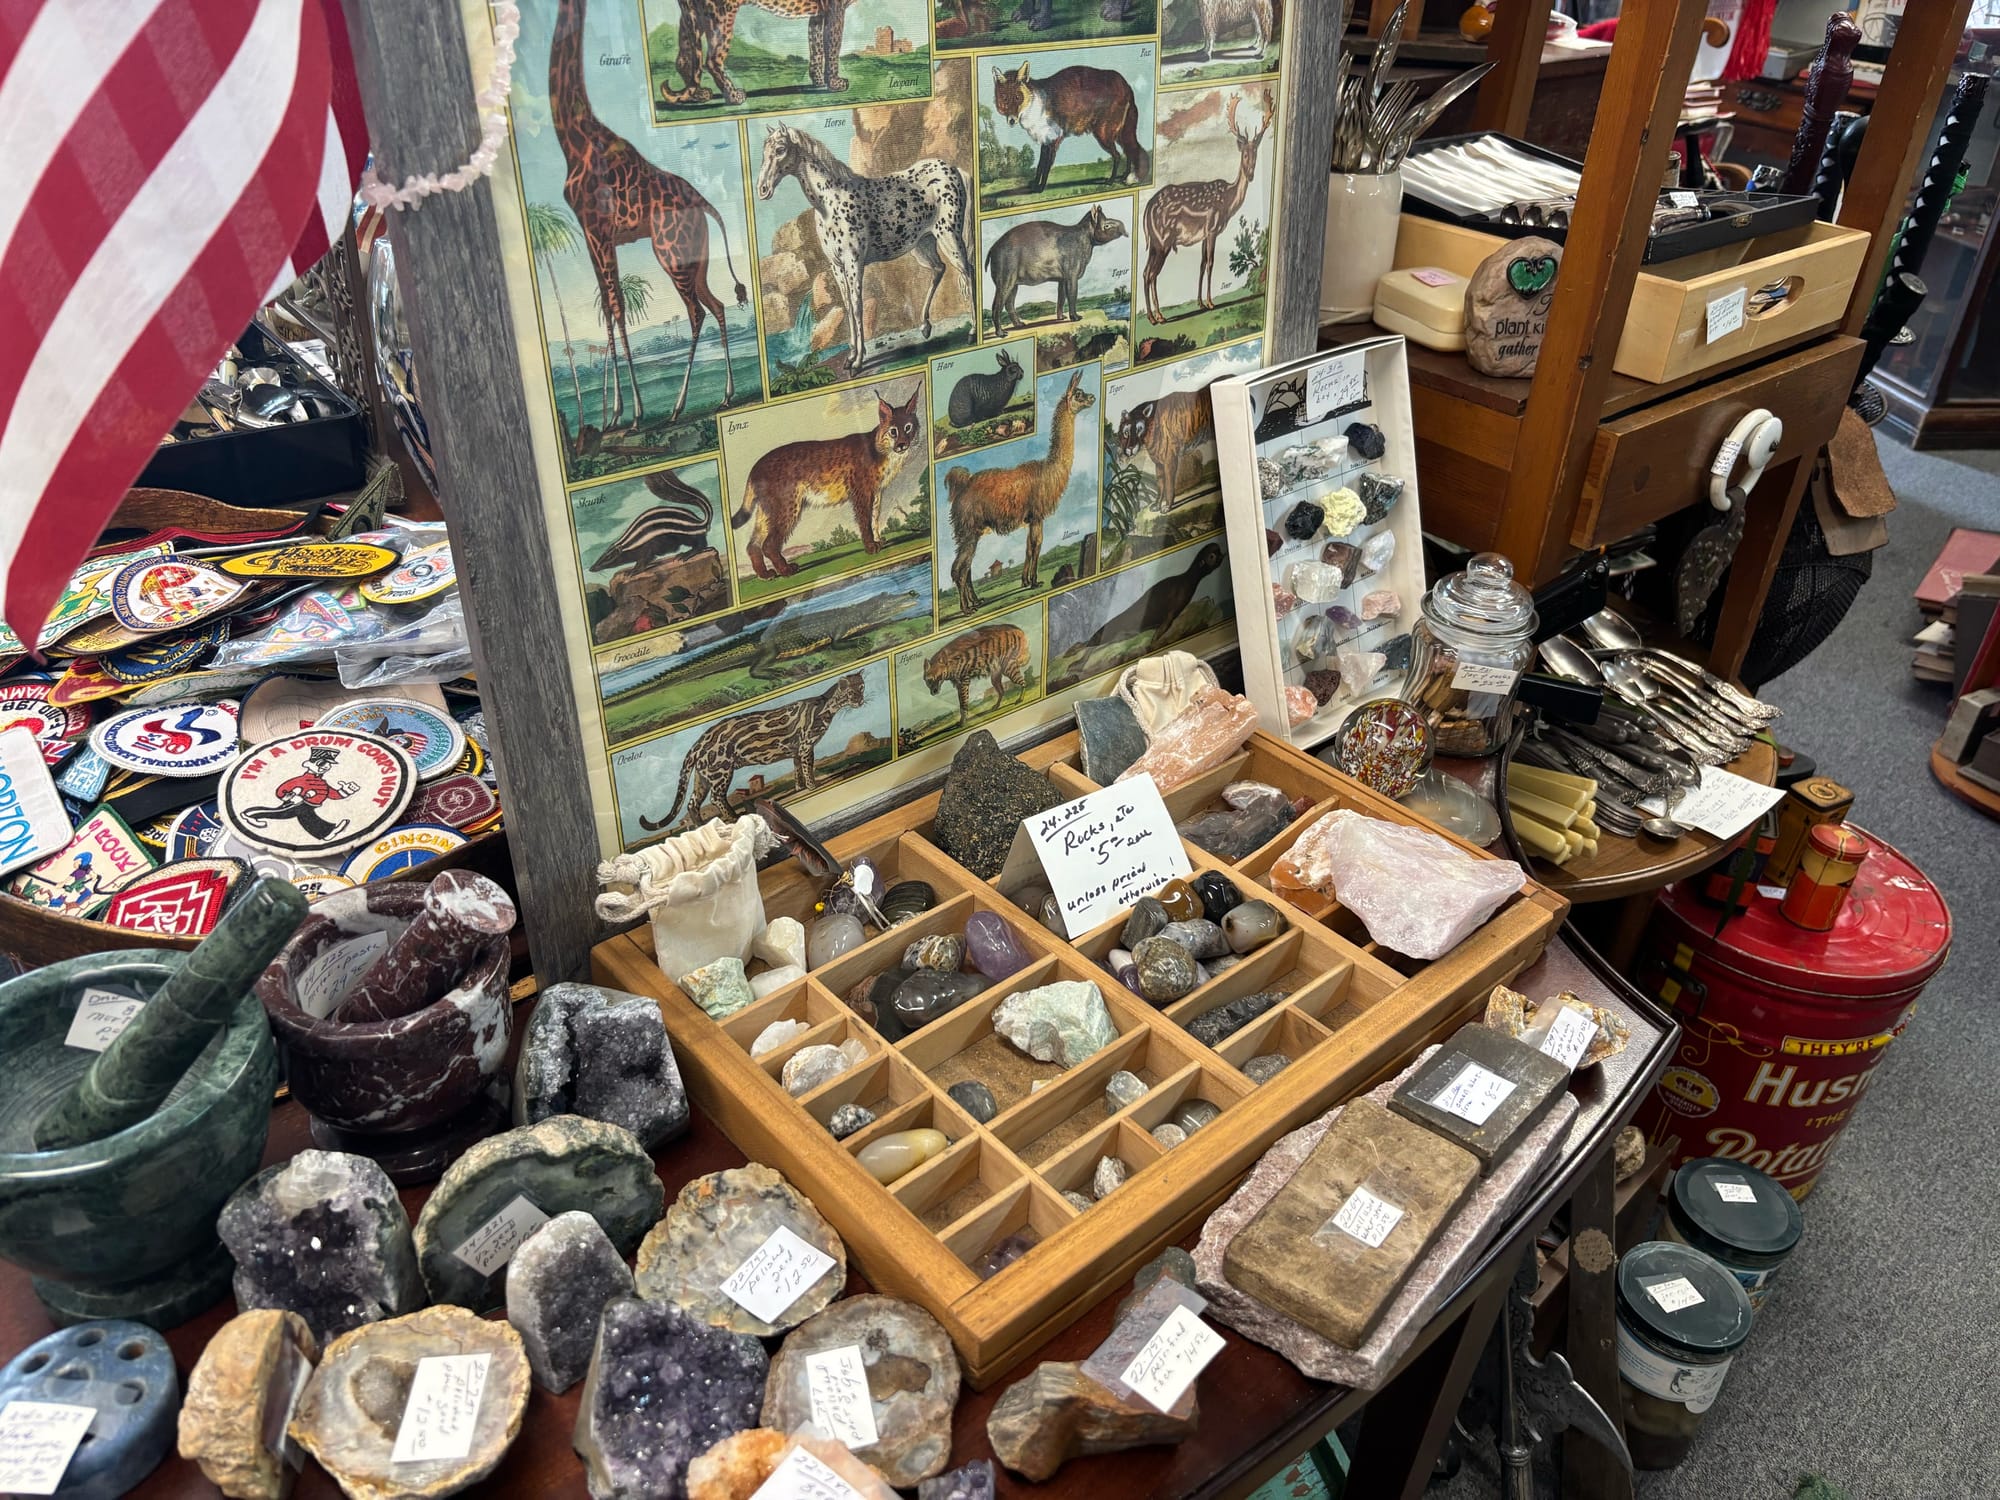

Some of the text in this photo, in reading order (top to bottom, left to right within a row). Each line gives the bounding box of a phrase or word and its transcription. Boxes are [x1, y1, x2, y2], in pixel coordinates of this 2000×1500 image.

[599, 53, 632, 67] Giraffe
[824, 118, 847, 128] Horse
[1495, 319, 1531, 338] plant
[1497, 336, 1538, 361] gather
[936, 362, 954, 372] Hare
[728, 421, 749, 435] Lynx
[576, 493, 608, 509] Skunk
[614, 647, 652, 664] Crocodile
[141, 755, 213, 768] NATIONAL
[617, 750, 644, 766] Ocelot
[240, 736, 398, 808] I'M A DRUM CORPS NUT
[374, 833, 455, 855] CINCIN
[1798, 1038, 1873, 1056] THEY'RE
